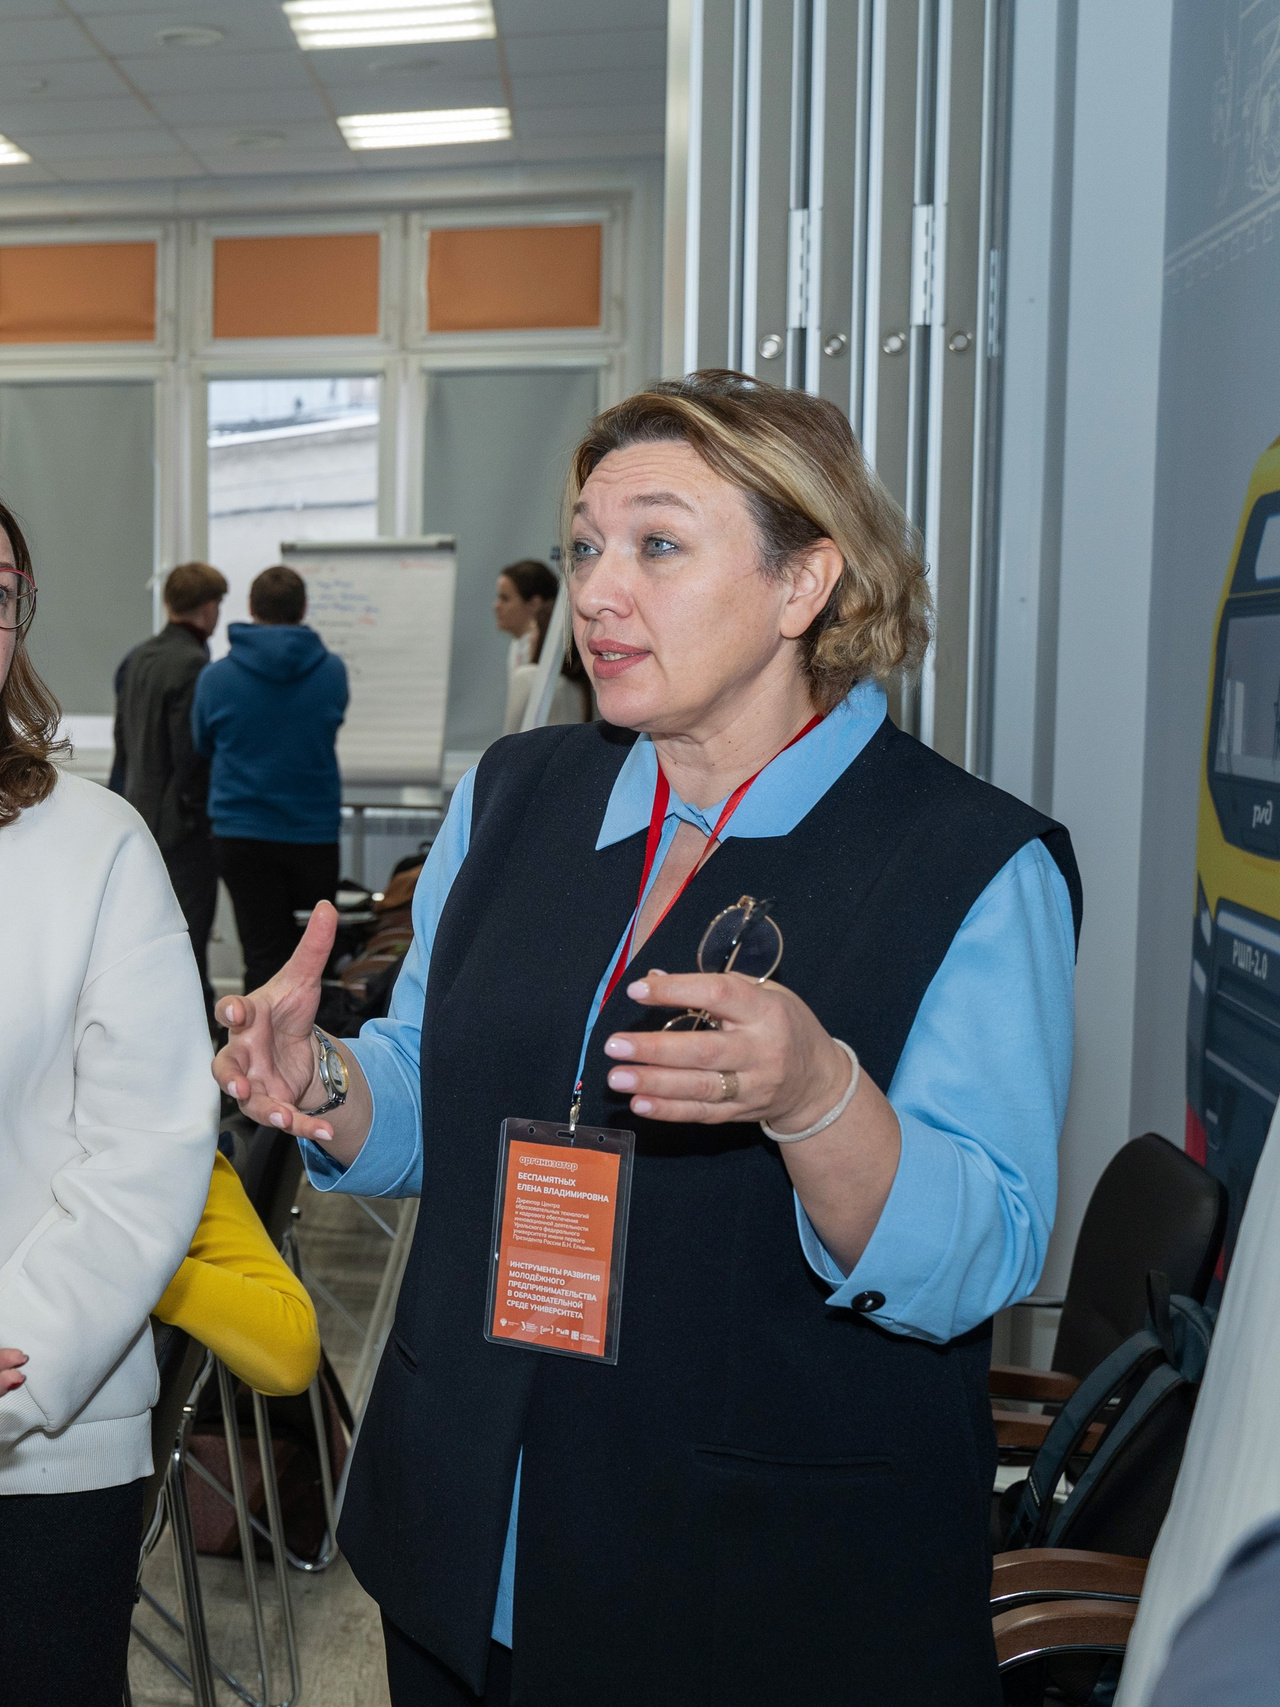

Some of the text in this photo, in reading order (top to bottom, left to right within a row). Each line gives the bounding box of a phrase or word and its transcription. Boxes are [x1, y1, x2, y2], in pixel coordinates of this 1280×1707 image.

[519, 1156, 578, 1172] организатор
[518, 1172, 576, 1186] БЕСПАМЯТНЫХ
[516, 1197, 540, 1206] Директор
[517, 1183, 609, 1203] ЕЛЕНА ВЛАДИМИРОВНА
[509, 1270, 565, 1286] МОЛОДЁЖНОГО
[510, 1261, 600, 1282] ИНСТРУМЕНТЫ РАЗВИТИЯ
[508, 1280, 597, 1301] ПРЕДПРИНИМАТЕЛЬСТВА
[514, 1292, 583, 1309] ОБРАЗОВАТЕЛЬНОЙ
[506, 1300, 584, 1319] СРЕДЕ УНИВЕРСИТЕТА
